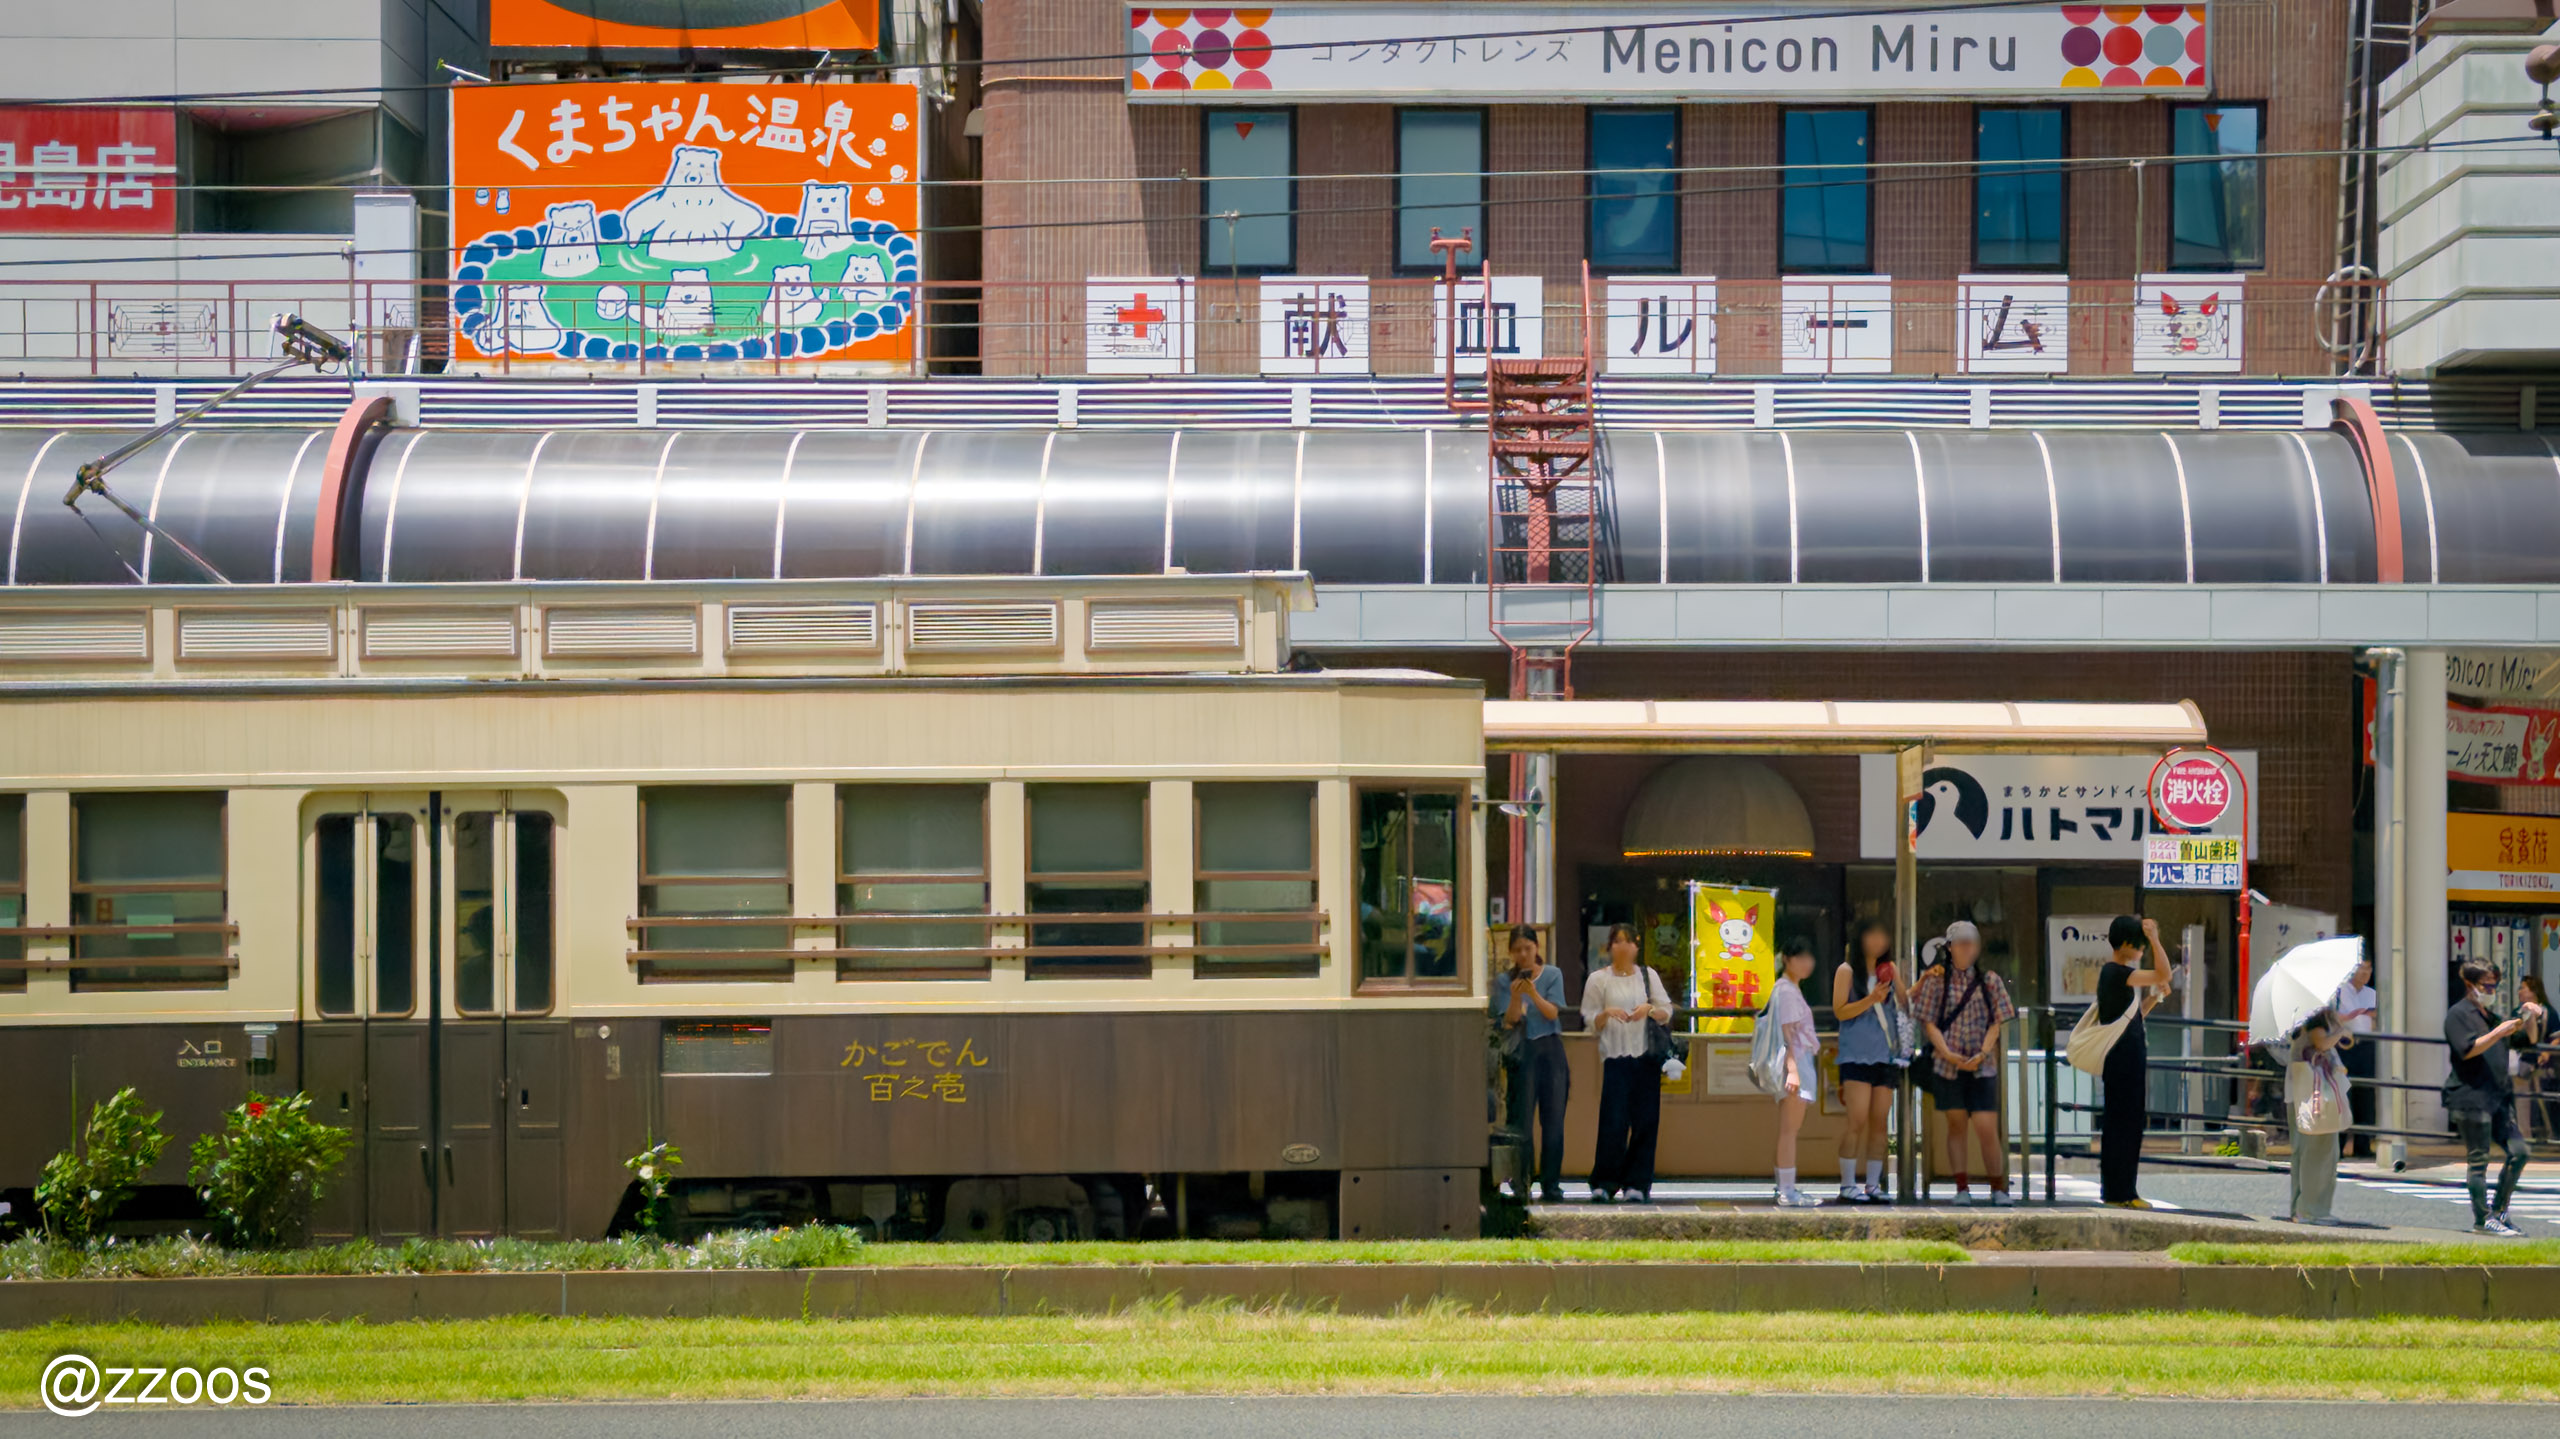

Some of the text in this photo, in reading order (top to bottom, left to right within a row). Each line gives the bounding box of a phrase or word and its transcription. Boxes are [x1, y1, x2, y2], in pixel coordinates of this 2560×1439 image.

[1311, 36, 1572, 66] コンタクトレンズ
[1602, 25, 2017, 75] Menicon Miru
[498, 94, 873, 171] くまちゃん温泉
[2167, 778, 2225, 805] 消火栓
[178, 1040, 222, 1055] 入口
[840, 1037, 989, 1067] かごでん
